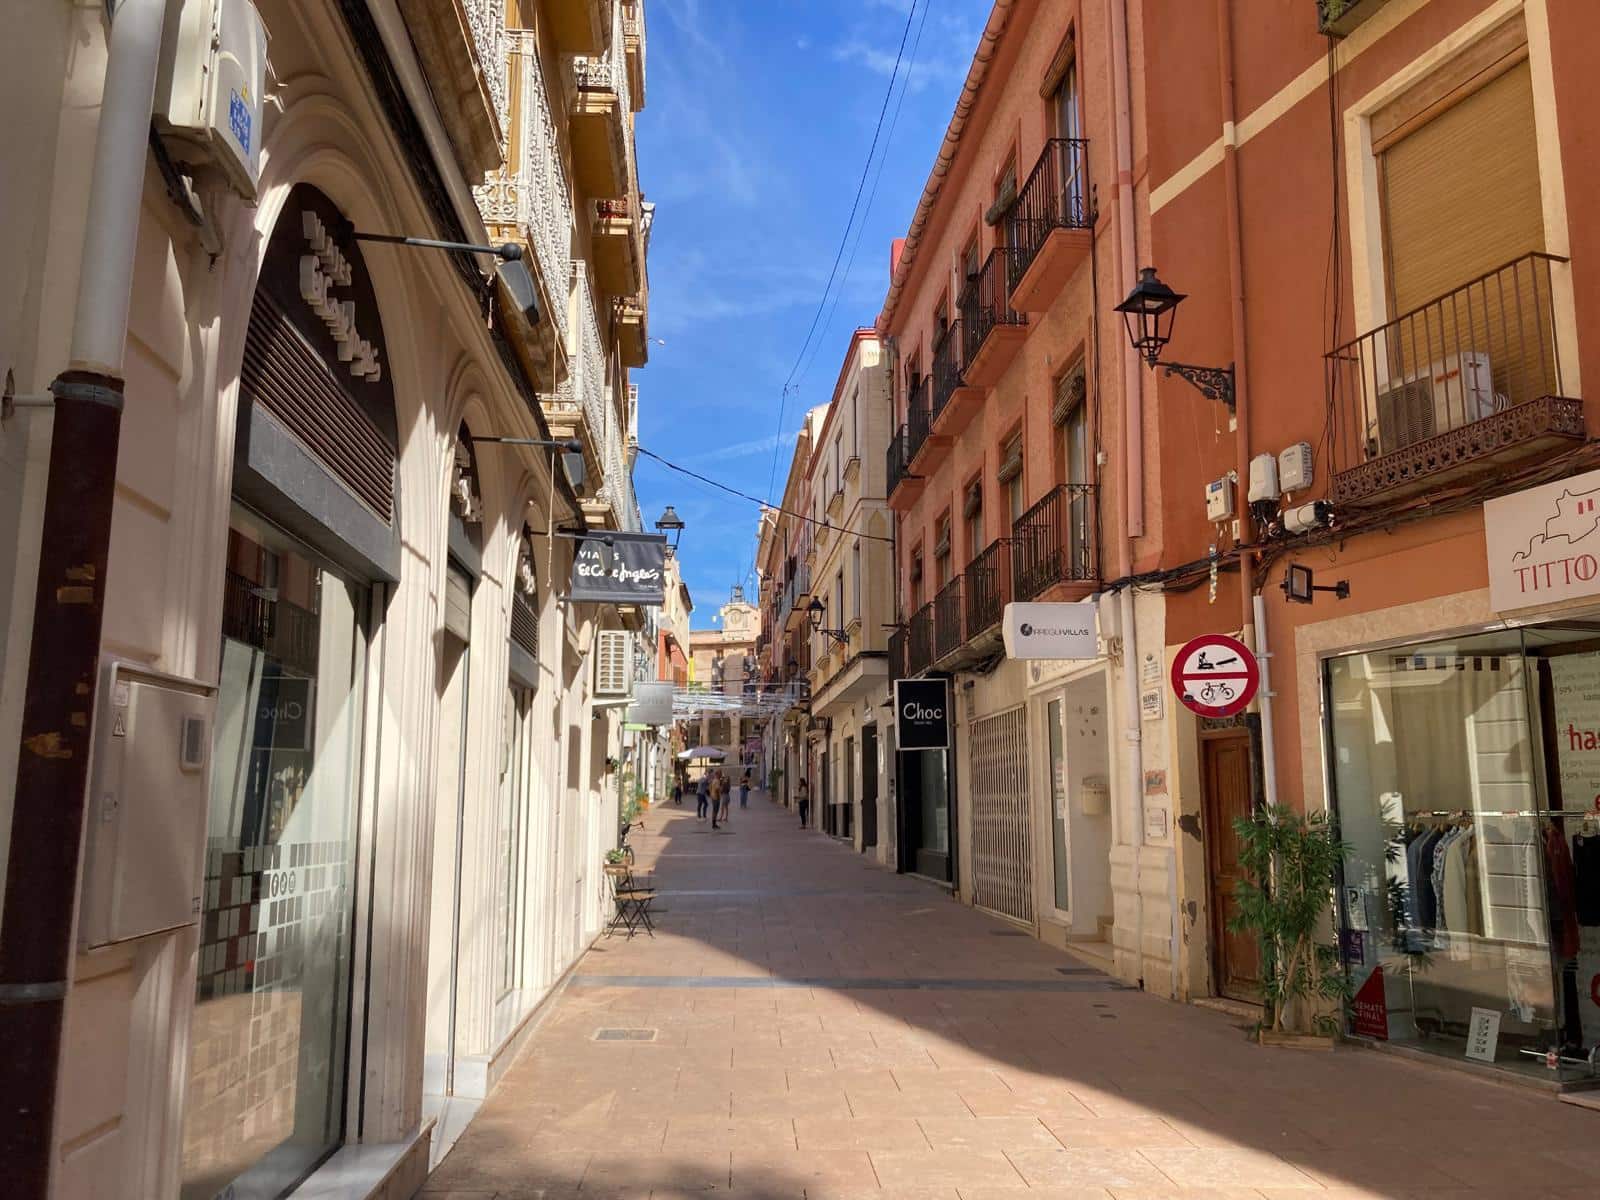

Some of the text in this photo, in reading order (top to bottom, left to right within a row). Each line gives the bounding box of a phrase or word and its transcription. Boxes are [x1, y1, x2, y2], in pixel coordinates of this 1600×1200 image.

[579, 551, 619, 560] VIAS
[1512, 554, 1598, 592] TITTO
[903, 702, 943, 720] Choc
